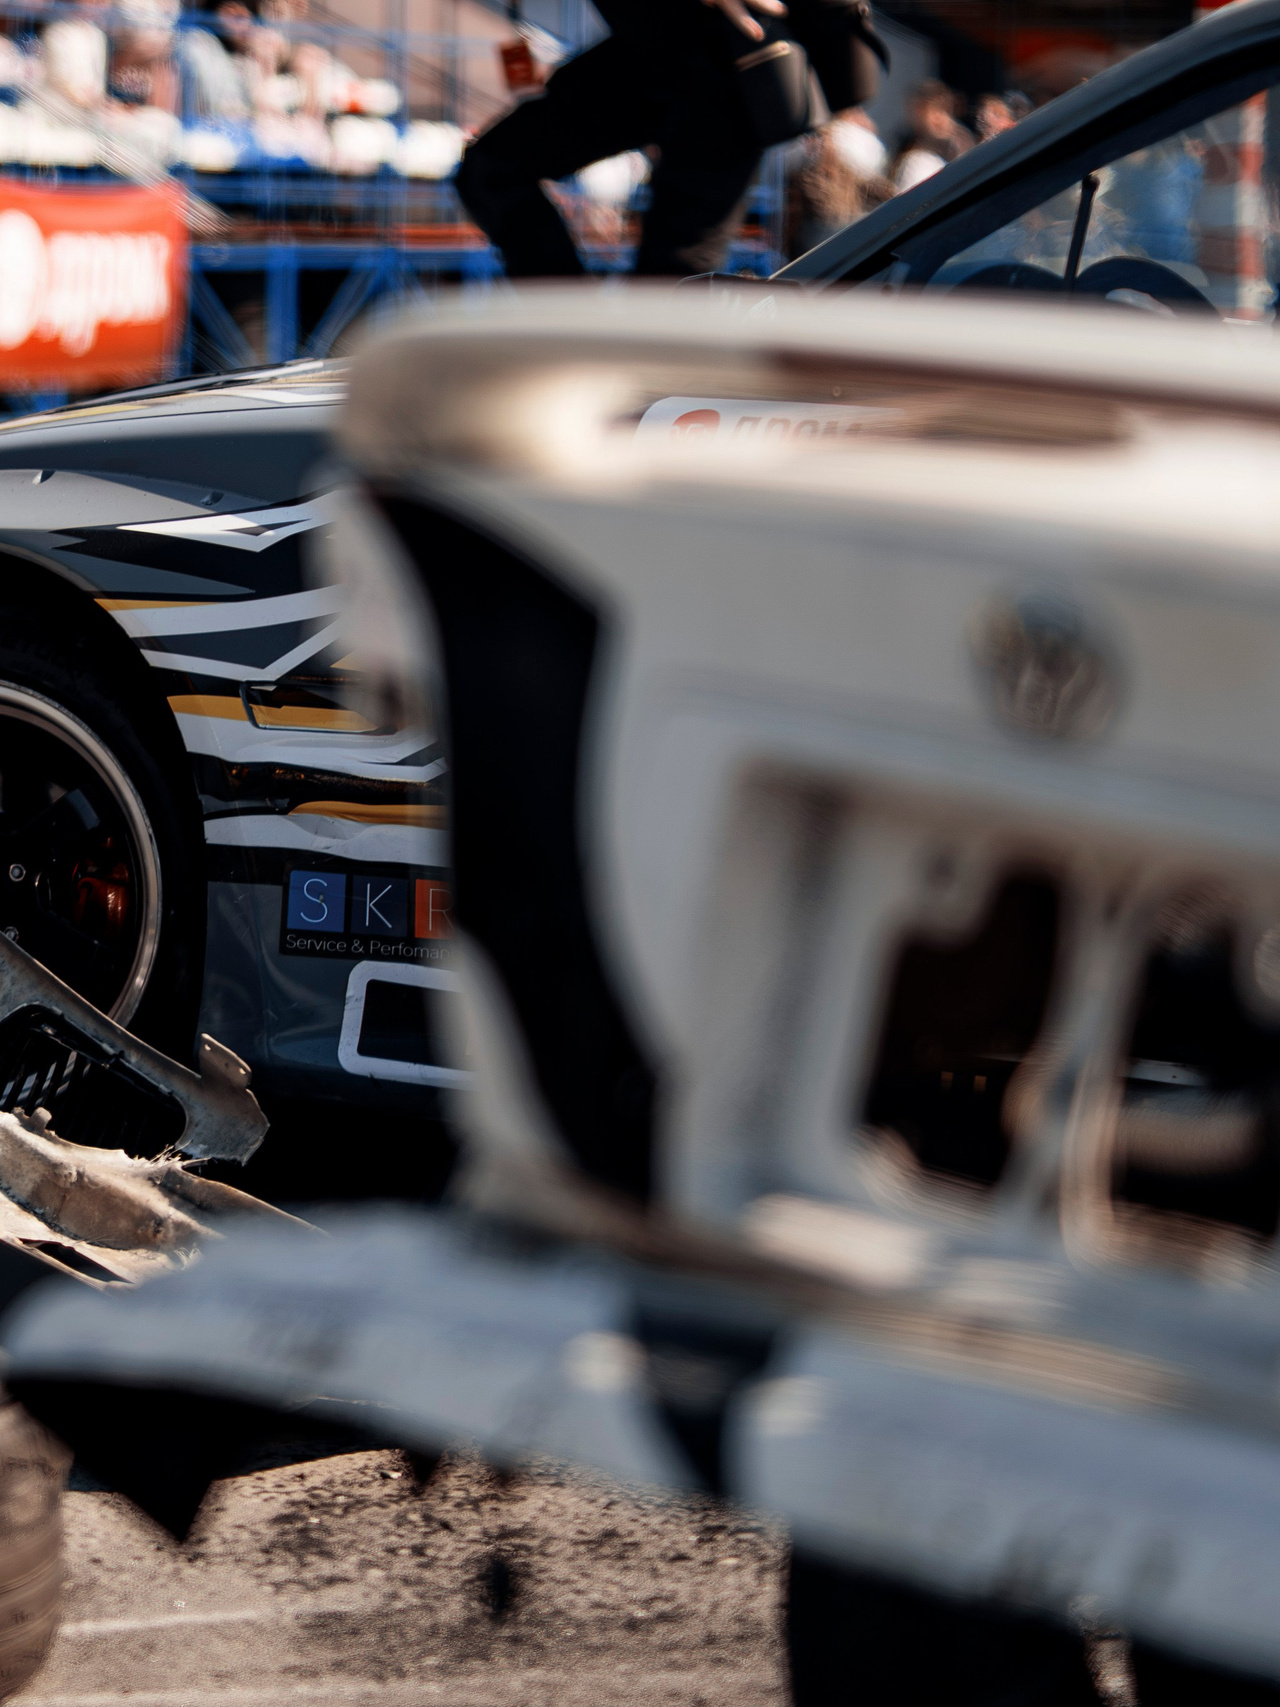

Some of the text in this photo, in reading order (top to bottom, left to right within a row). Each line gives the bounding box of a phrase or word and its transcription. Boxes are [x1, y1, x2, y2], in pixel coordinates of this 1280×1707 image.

[286, 934, 452, 959] Service & Perfoman
